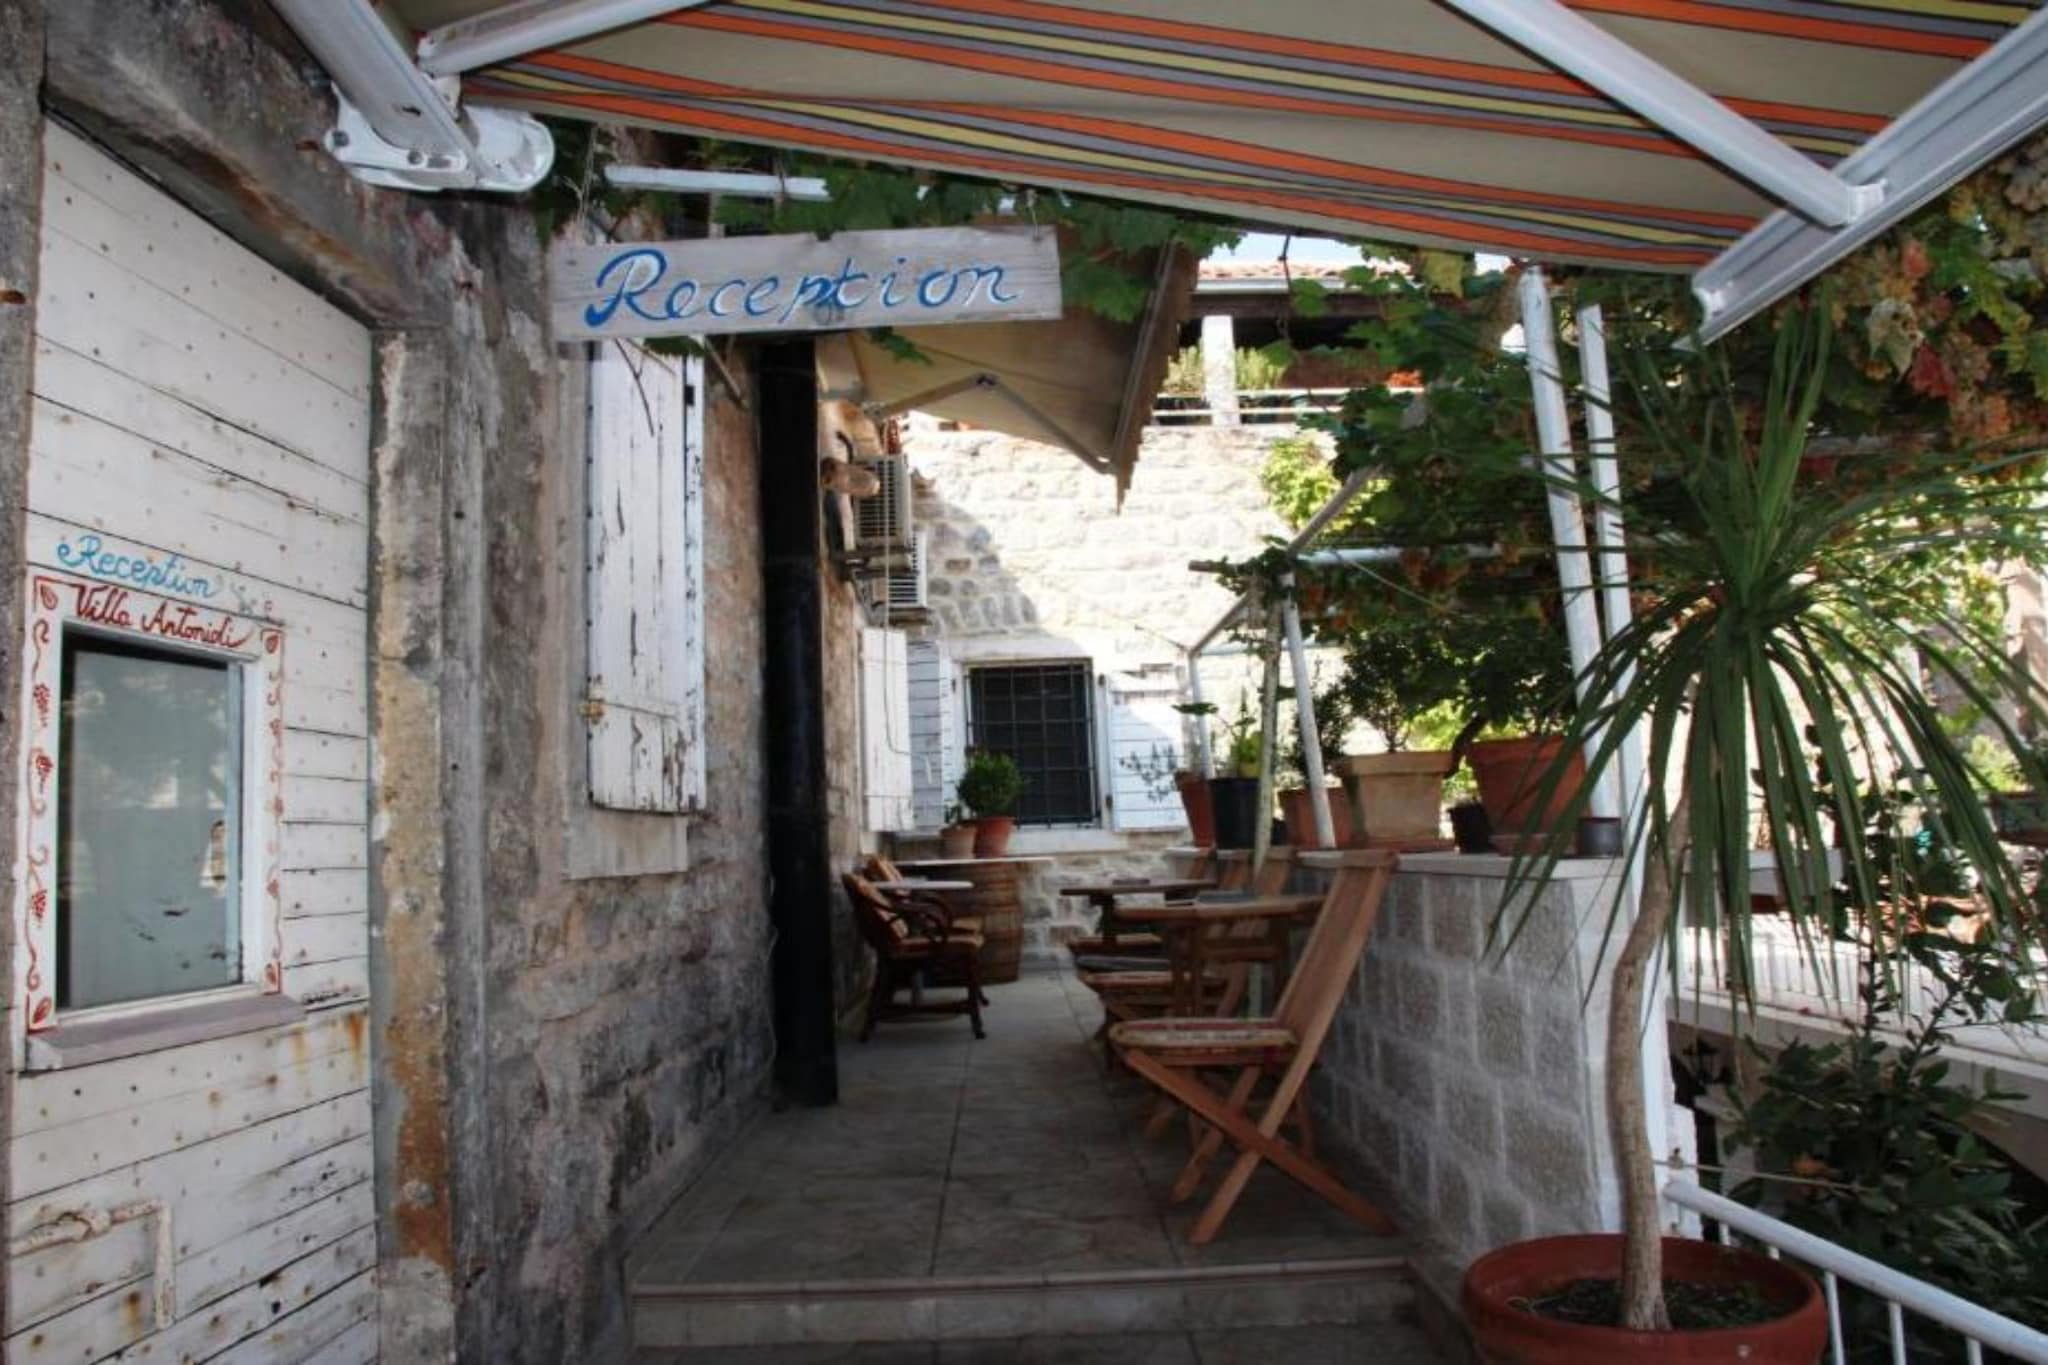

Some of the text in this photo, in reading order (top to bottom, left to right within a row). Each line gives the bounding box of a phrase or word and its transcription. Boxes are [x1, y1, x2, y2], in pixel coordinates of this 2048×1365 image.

[585, 248, 1017, 327] Reception
[57, 535, 219, 598] Reception
[70, 584, 132, 626] Villa
